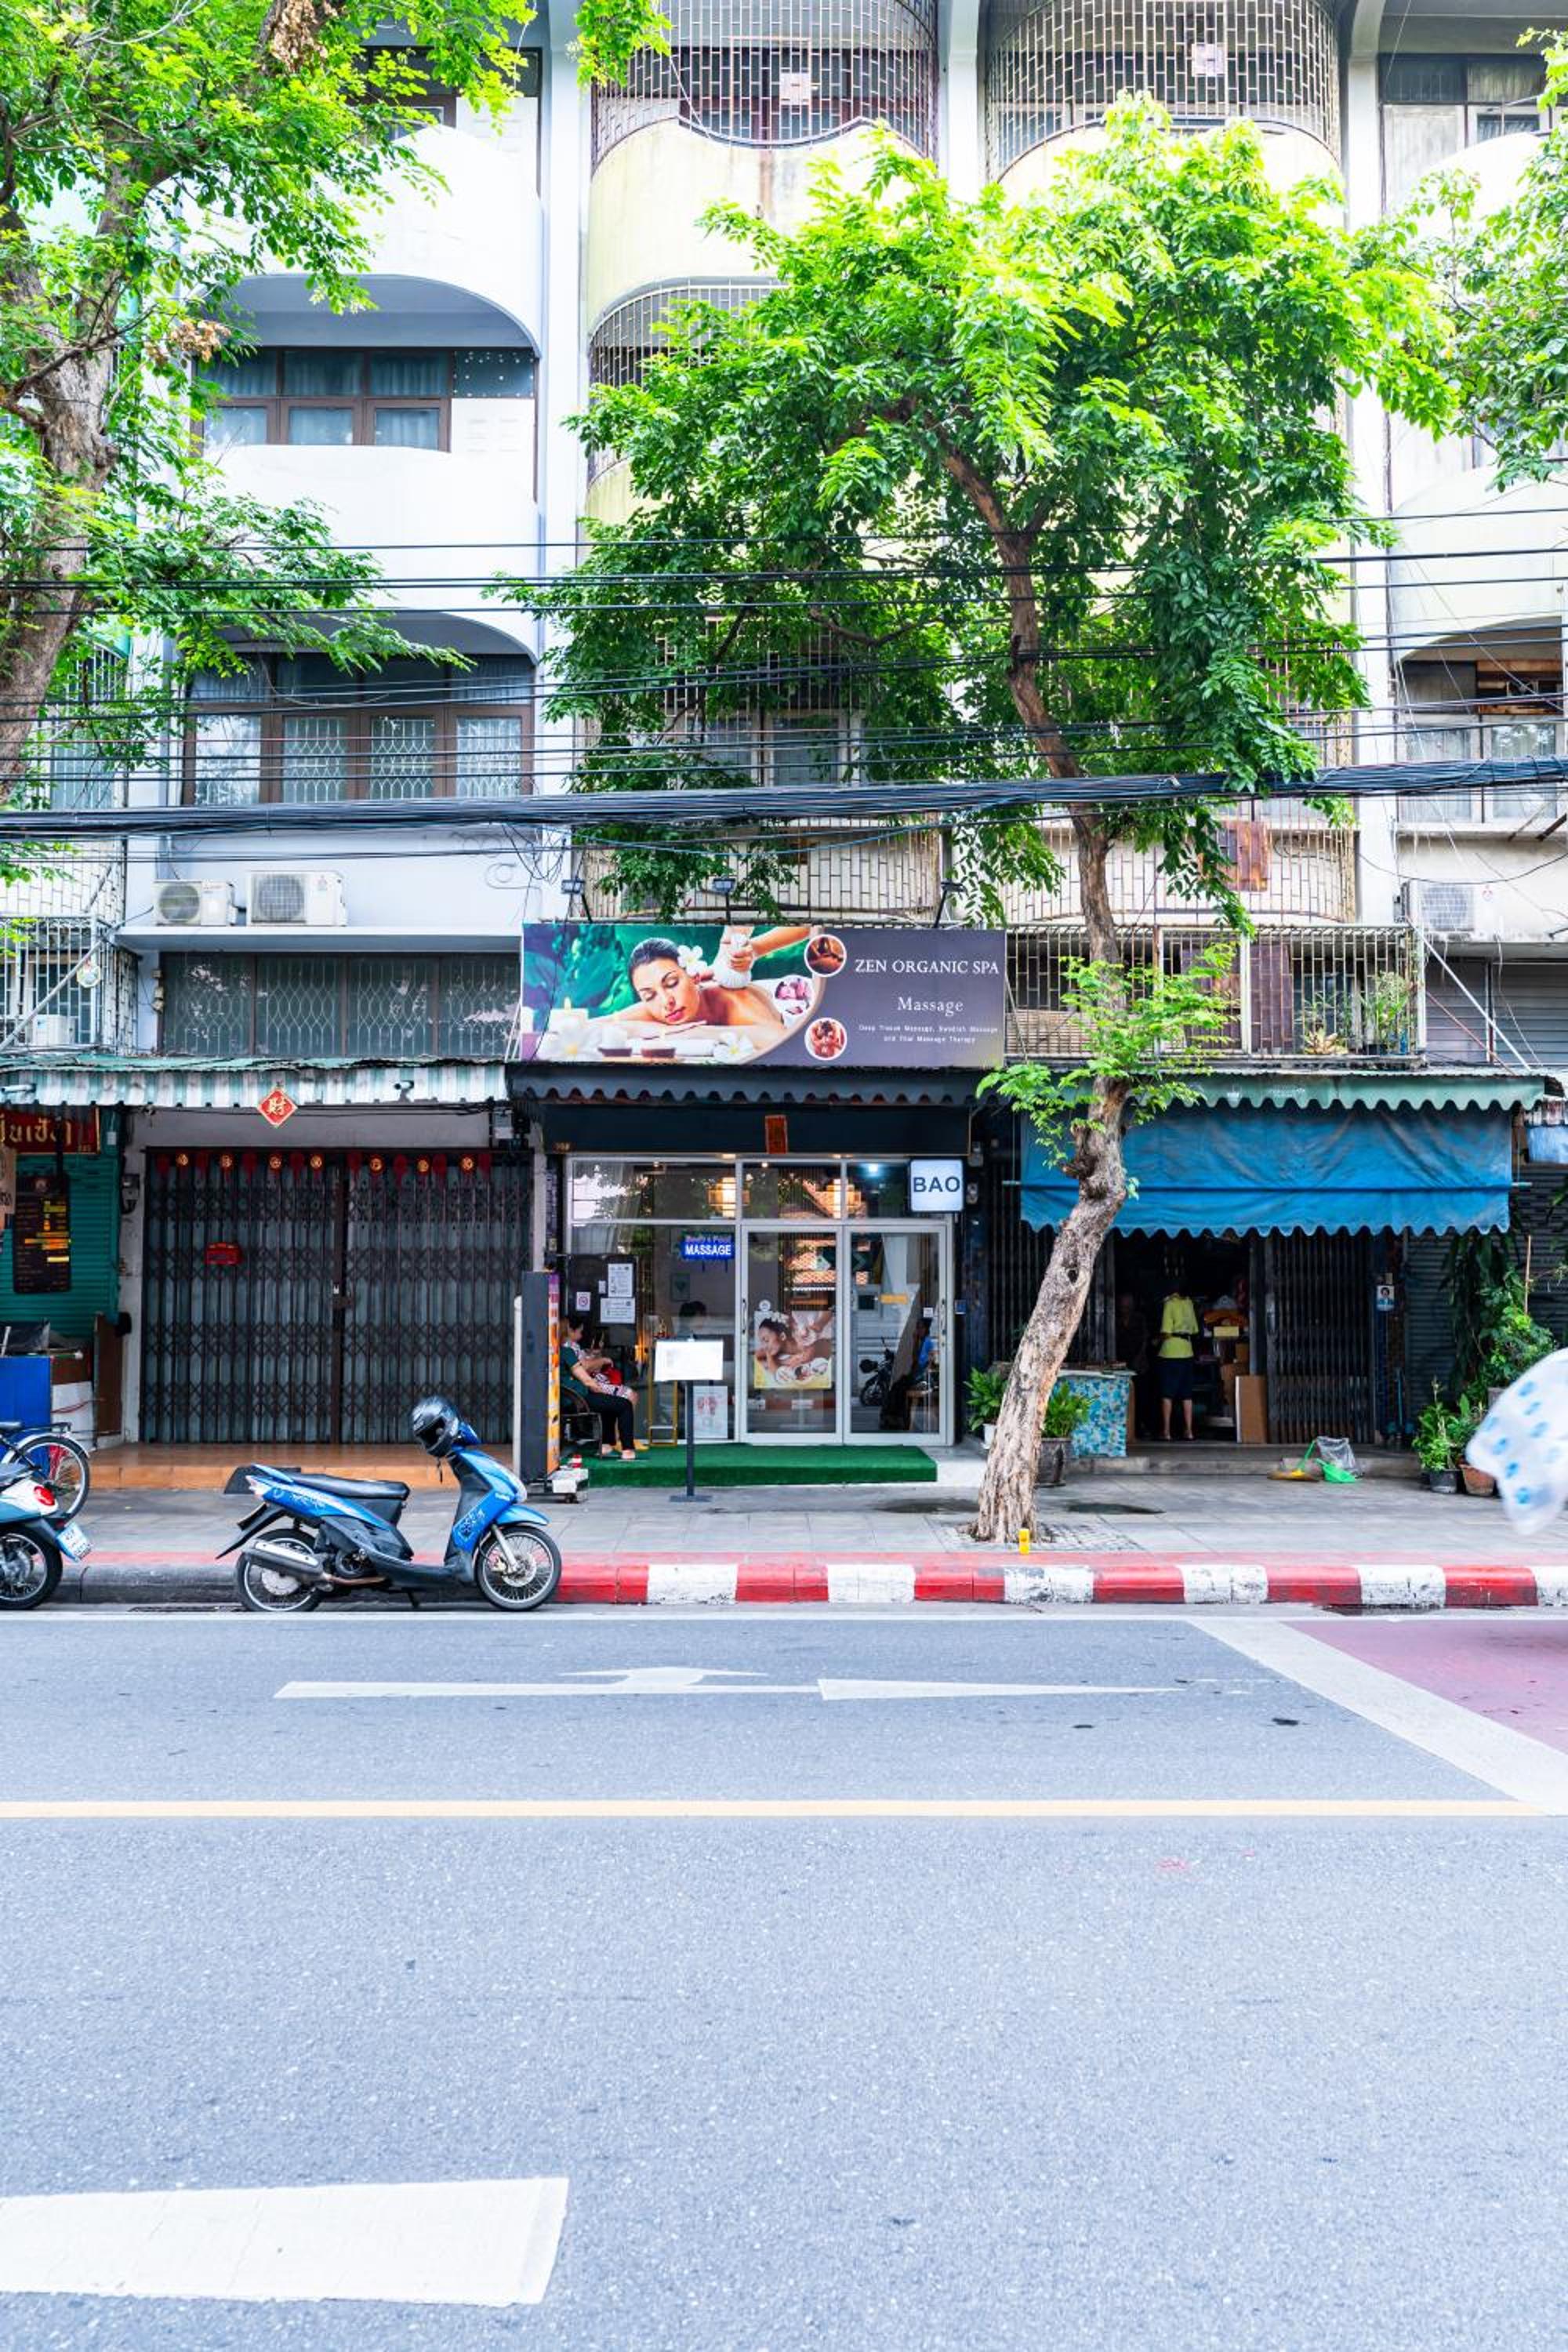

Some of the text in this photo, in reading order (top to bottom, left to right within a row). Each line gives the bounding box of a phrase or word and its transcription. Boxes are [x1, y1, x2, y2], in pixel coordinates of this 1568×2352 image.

[855, 959, 1000, 975] ZEN ORGANIC SPA
[898, 996, 964, 1017] Massage
[913, 1176, 960, 1192] BAO
[684, 1244, 731, 1255] MASSAGE
